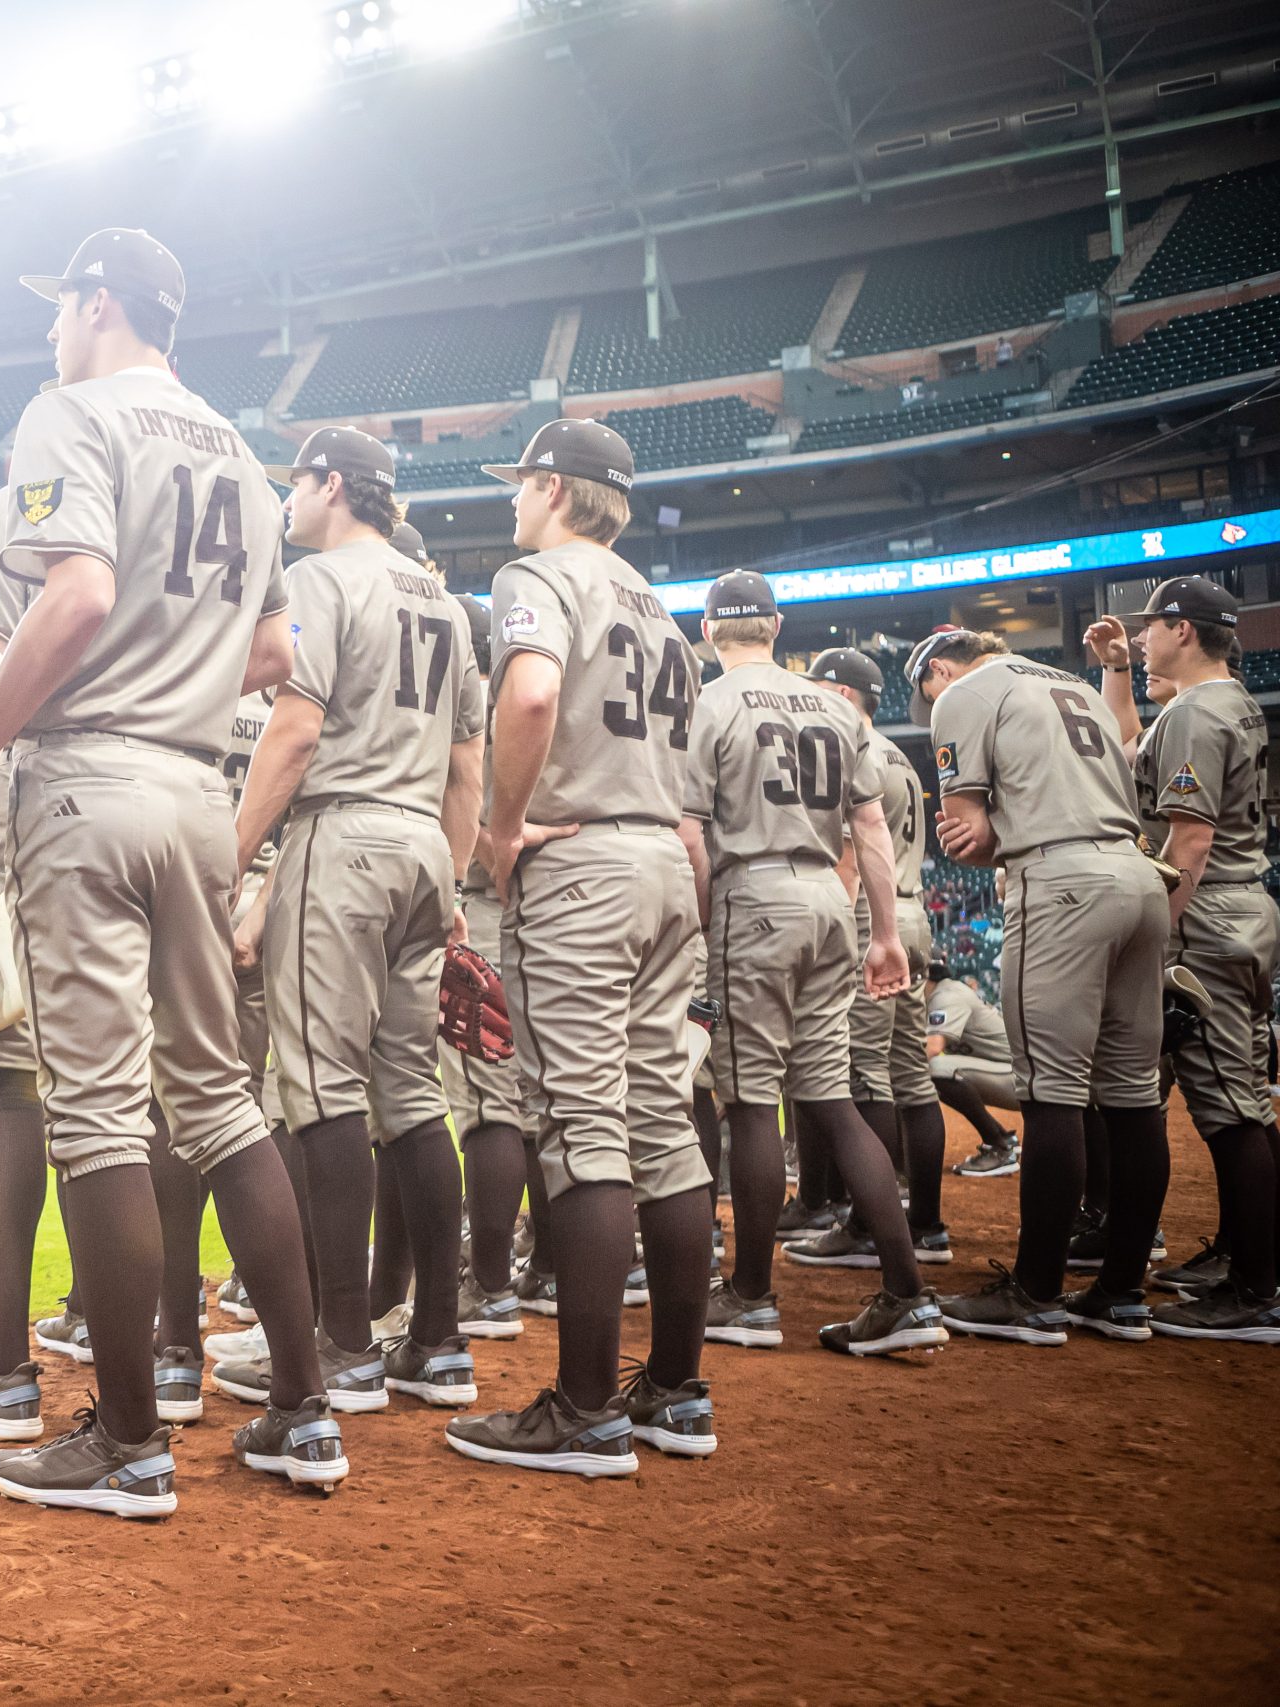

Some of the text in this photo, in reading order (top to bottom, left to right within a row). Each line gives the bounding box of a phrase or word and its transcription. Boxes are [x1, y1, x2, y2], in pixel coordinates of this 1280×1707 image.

[131, 406, 251, 464] INTEGRIT
[163, 463, 248, 608] 14
[716, 606, 741, 617] TEXAS
[395, 607, 453, 715] 17
[602, 622, 689, 752] 34
[741, 689, 828, 714] COURAGE
[1049, 687, 1106, 760] 6
[755, 721, 843, 811] 30
